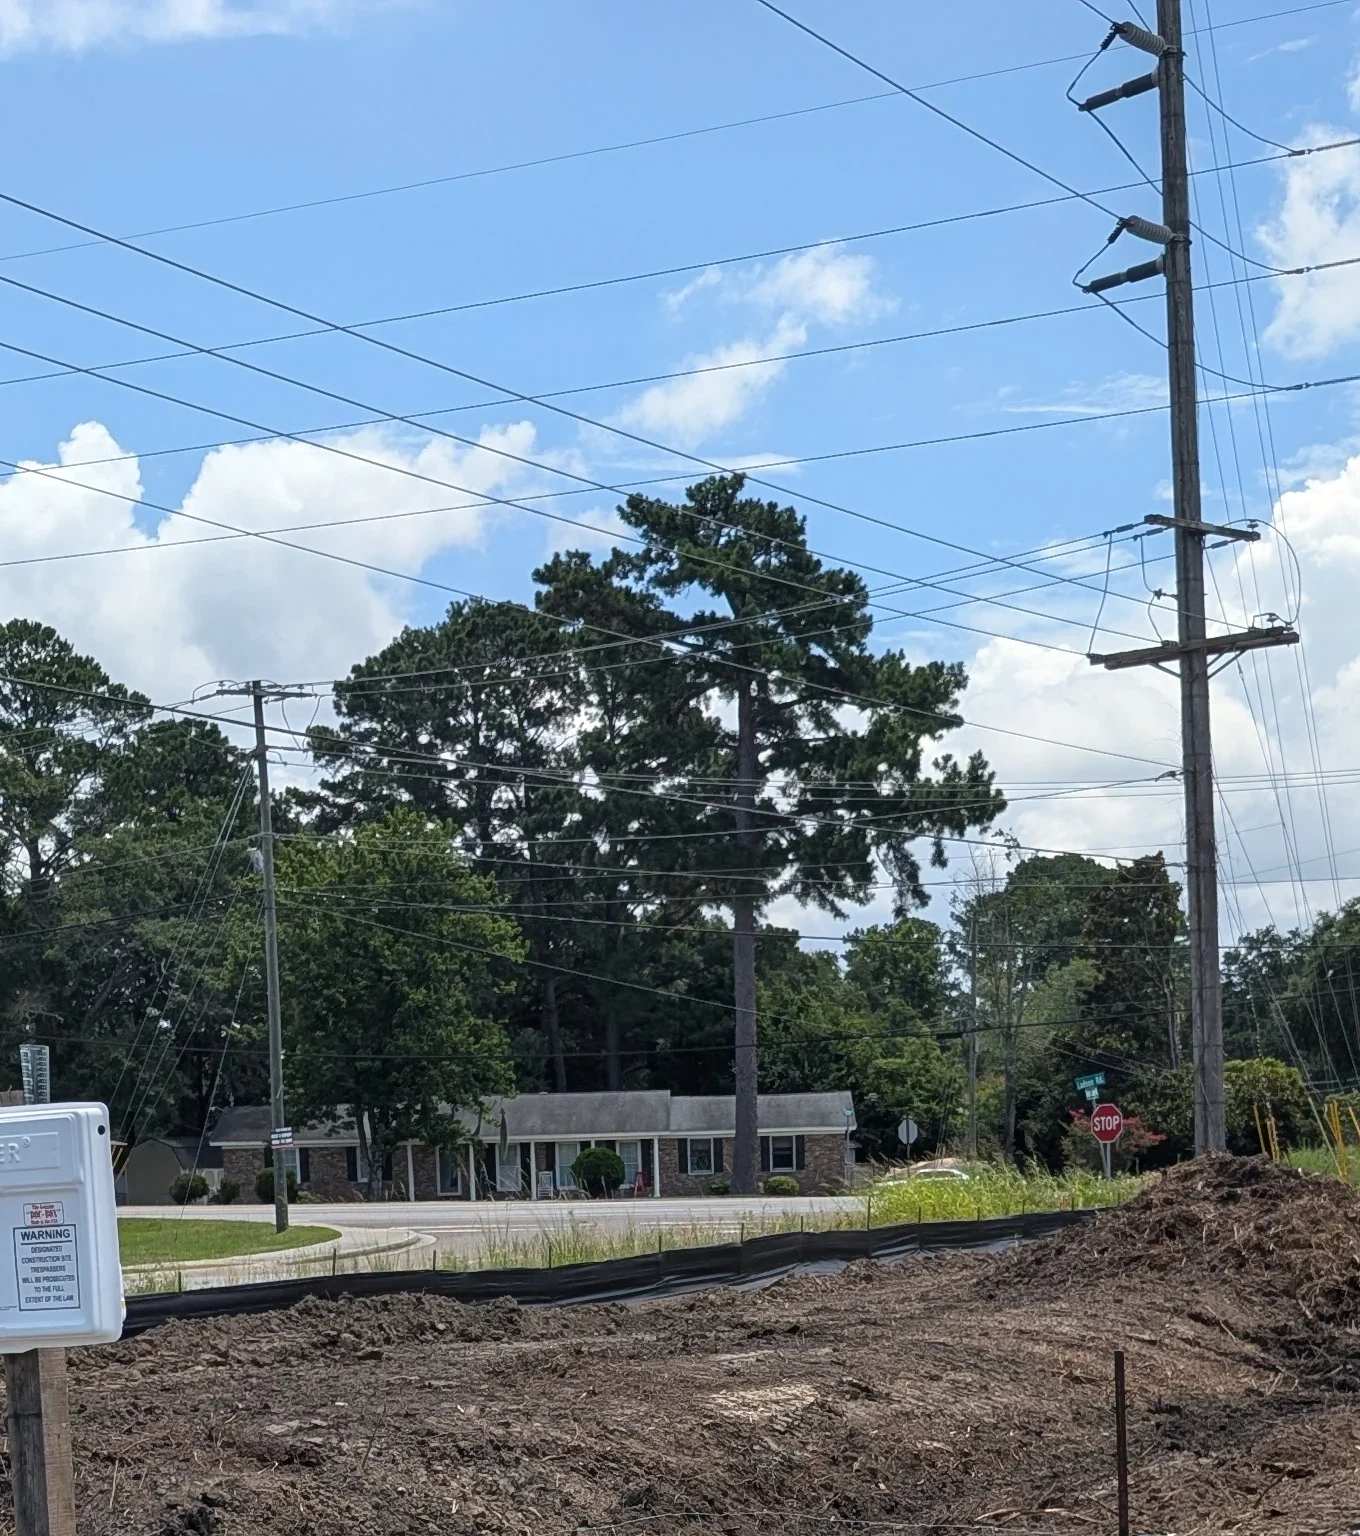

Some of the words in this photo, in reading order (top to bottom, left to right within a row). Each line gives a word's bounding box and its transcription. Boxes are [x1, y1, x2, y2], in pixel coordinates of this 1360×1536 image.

[1094, 1116, 1120, 1131] STOP
[21, 1229, 70, 1241] WARNING
[21, 1256, 60, 1264] CONSTRUCTION
[30, 1265, 66, 1273] TRESPASSERS
